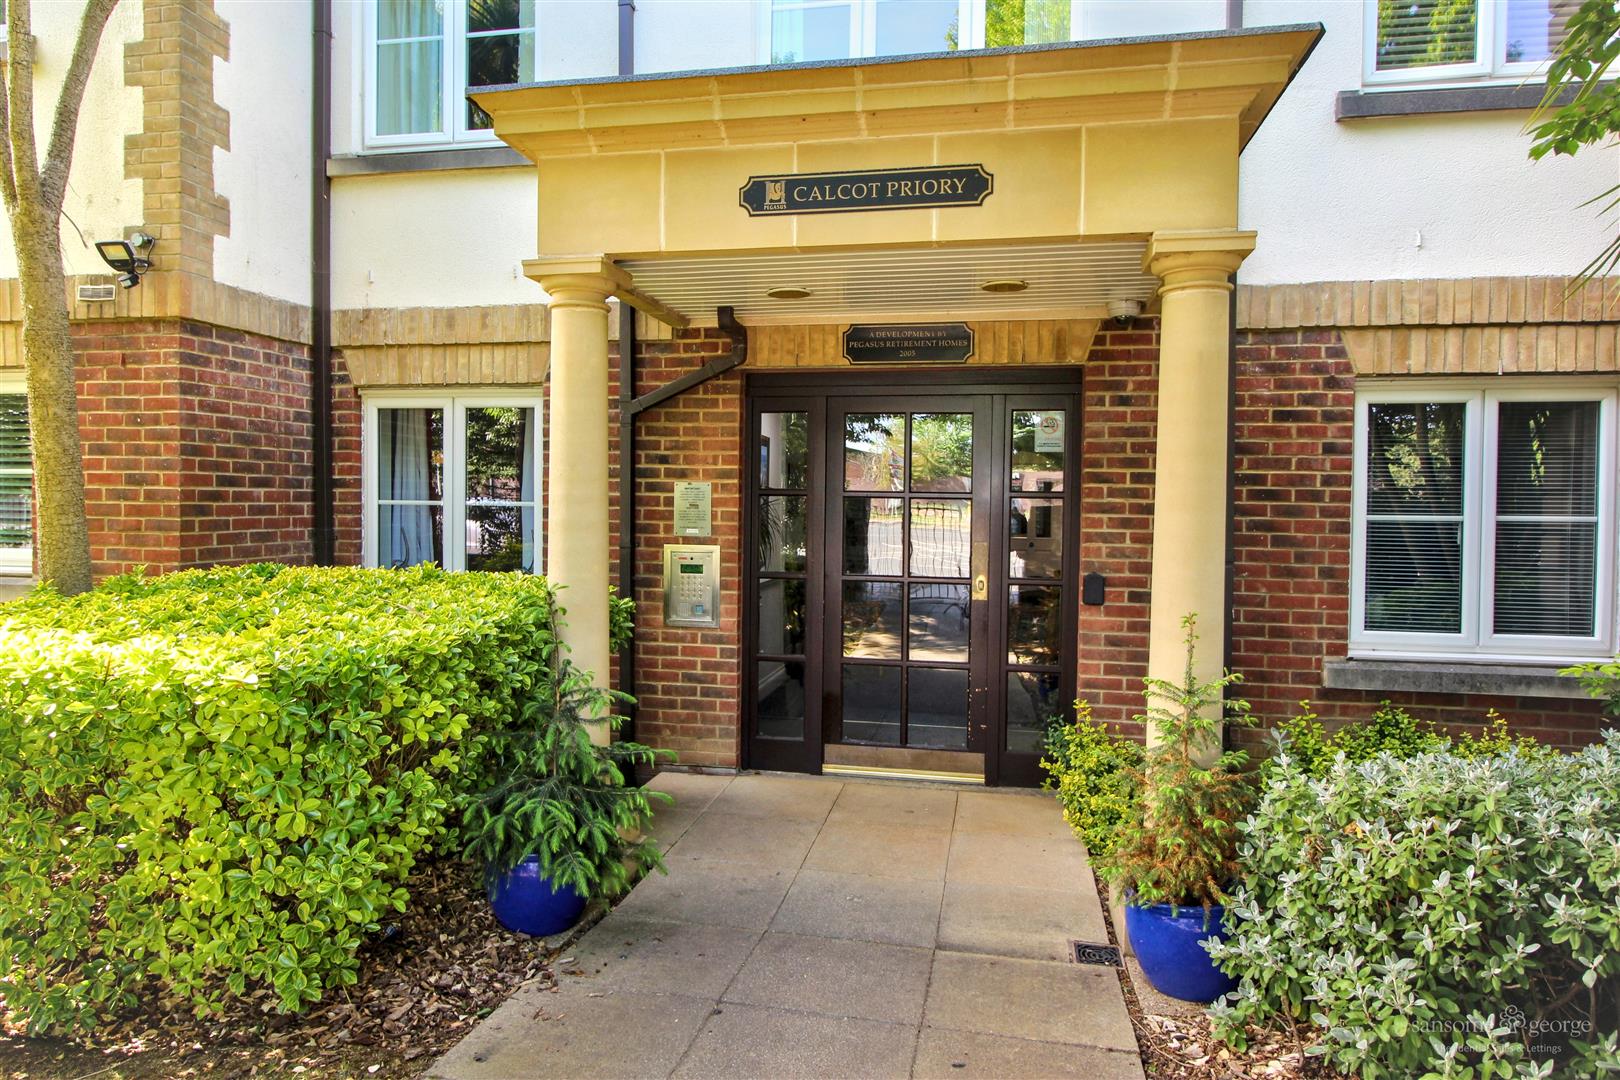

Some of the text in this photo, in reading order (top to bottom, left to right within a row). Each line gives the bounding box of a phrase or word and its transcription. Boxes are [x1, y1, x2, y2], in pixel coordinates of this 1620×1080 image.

[793, 177, 966, 202] CALCOT PRIORY
[875, 330, 936, 338] DEVELOPMENT
[849, 339, 968, 348] PEGASUS RETIREMENT HOMES
